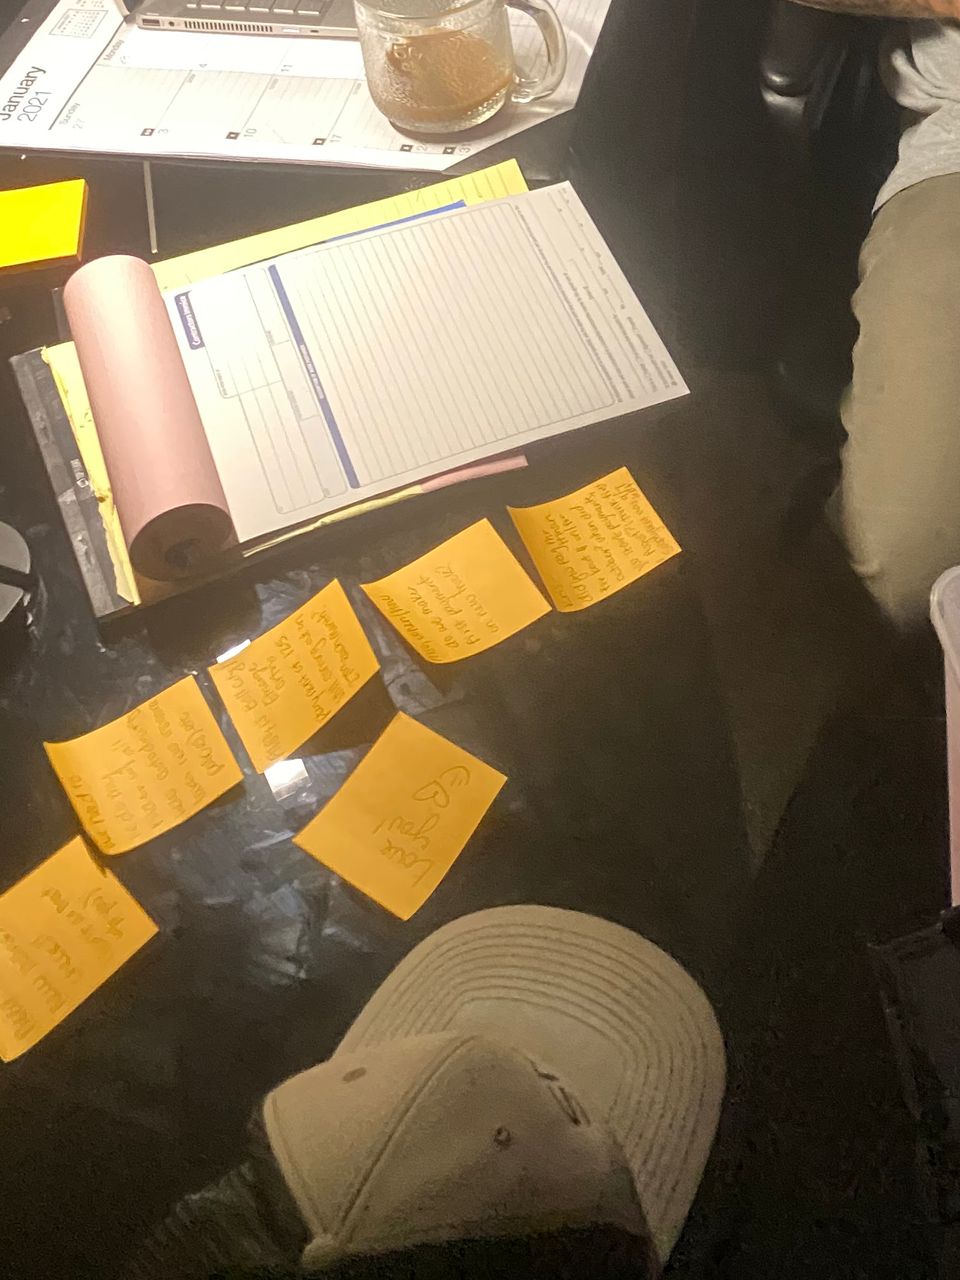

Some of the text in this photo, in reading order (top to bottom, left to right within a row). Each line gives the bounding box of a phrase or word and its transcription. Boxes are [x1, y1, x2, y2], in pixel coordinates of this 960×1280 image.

[0, 65, 45, 119] January
[17, 90, 51, 121] 2021
[408, 586, 459, 647] do we make
[465, 592, 487, 617] new
[485, 619, 499, 633] on
[381, 838, 432, 887] Love
